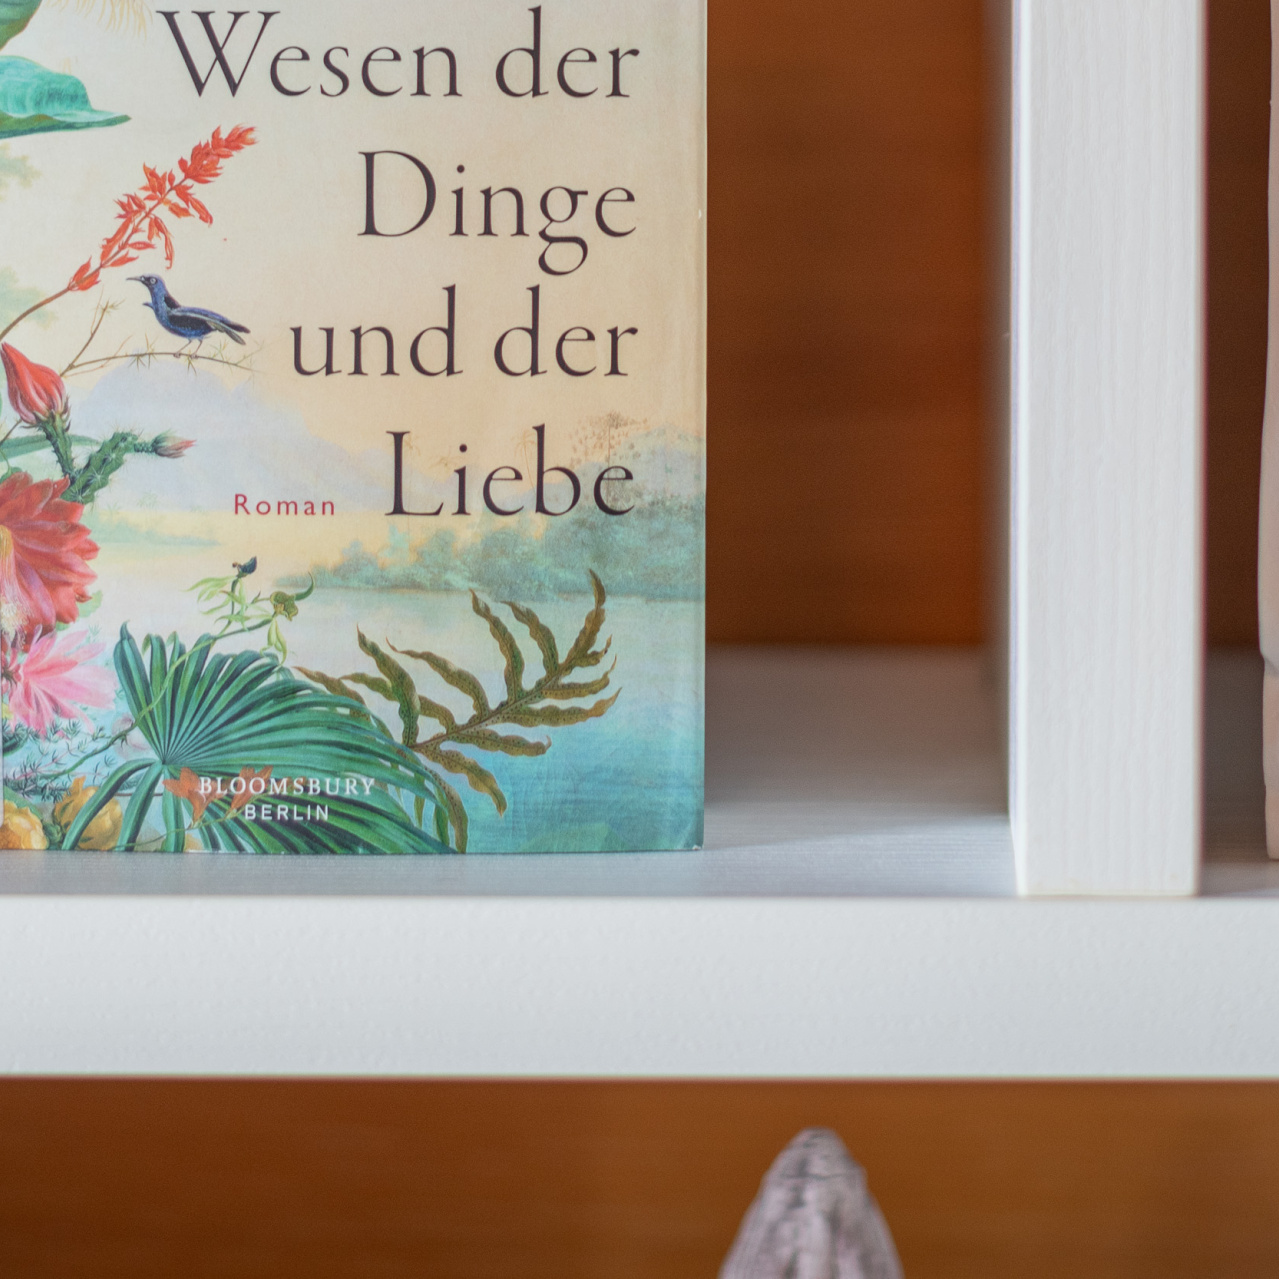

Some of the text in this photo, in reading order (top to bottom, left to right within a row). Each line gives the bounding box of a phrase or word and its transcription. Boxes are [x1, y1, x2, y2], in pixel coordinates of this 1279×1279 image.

[155, 5, 641, 99] Wesen der
[357, 150, 638, 277] Dinge
[289, 284, 640, 378] und der
[233, 493, 336, 516] Roman
[384, 423, 638, 518] Liebe
[198, 776, 376, 797] BLOOMSBURY
[244, 804, 330, 822] BERLIN
